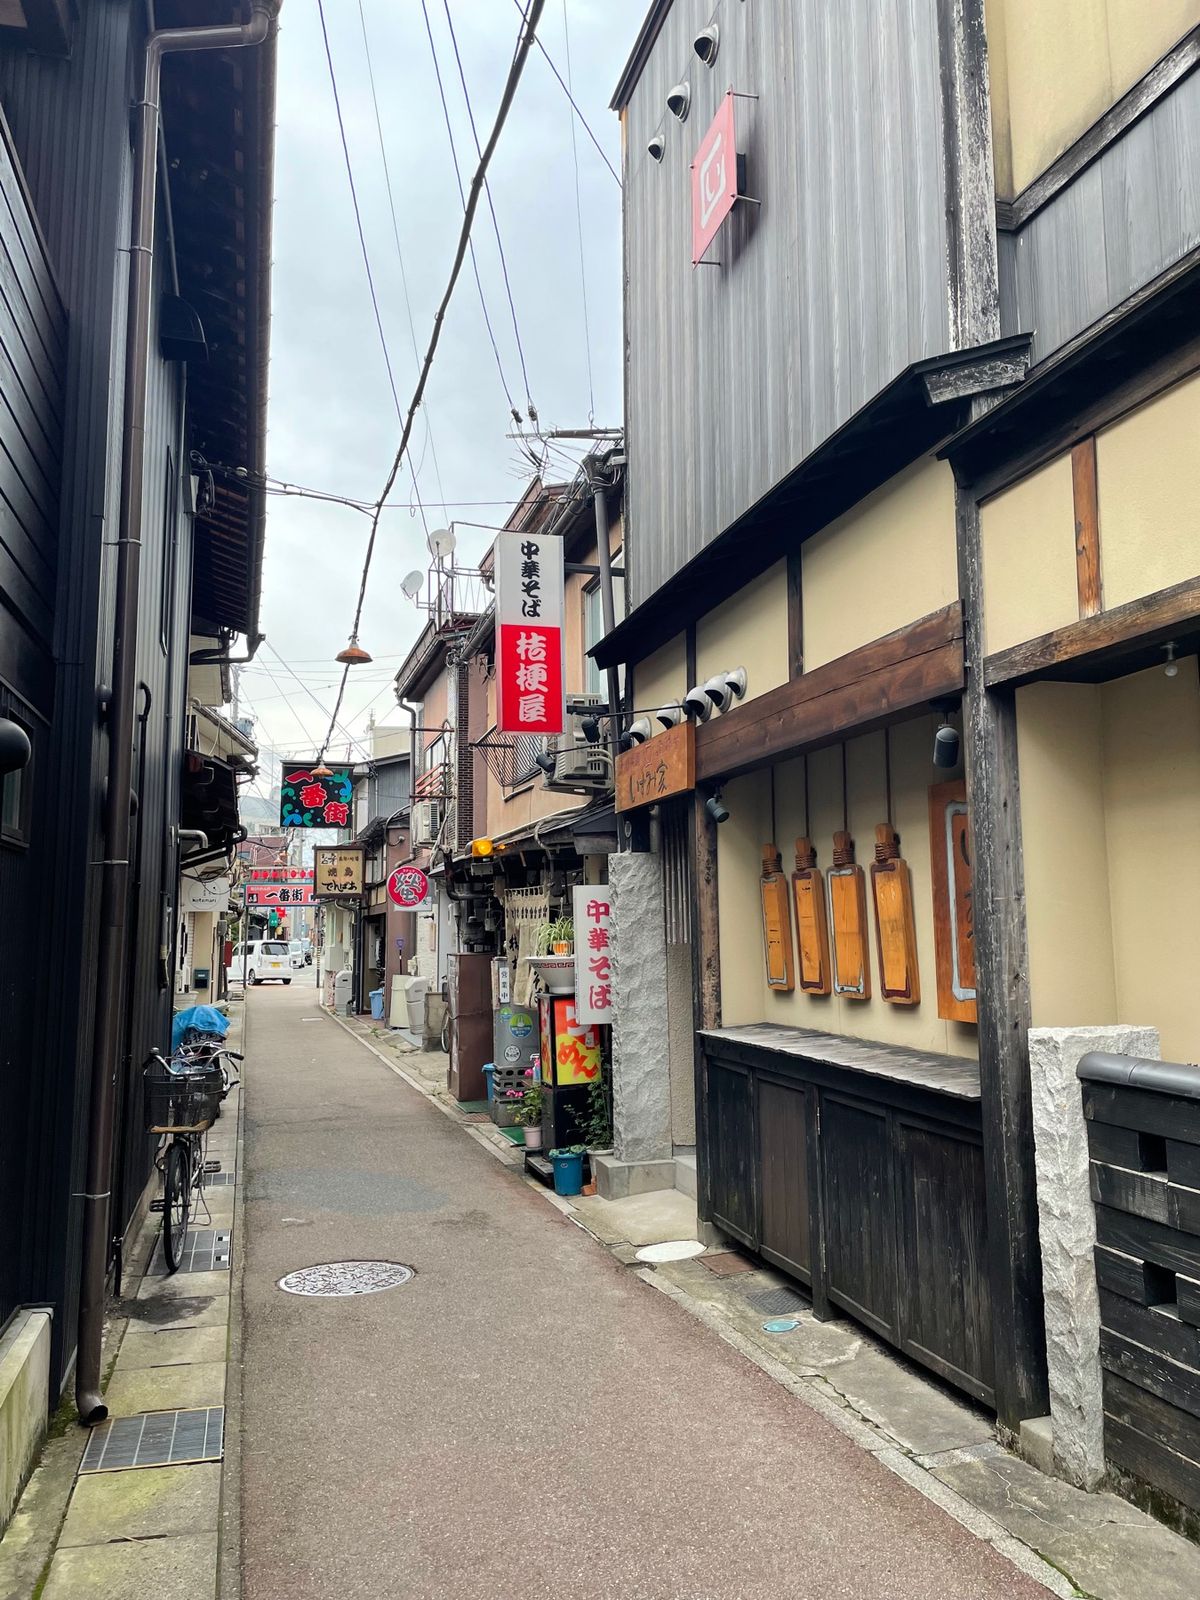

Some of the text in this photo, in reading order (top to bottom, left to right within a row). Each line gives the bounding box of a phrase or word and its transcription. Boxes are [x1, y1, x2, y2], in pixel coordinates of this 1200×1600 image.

[520, 541, 541, 617] 中華そば
[516, 632, 549, 723] 桔梗屋
[285, 770, 349, 827] 一番街
[264, 887, 304, 902] 一番街
[586, 899, 613, 1010] 中華そば
